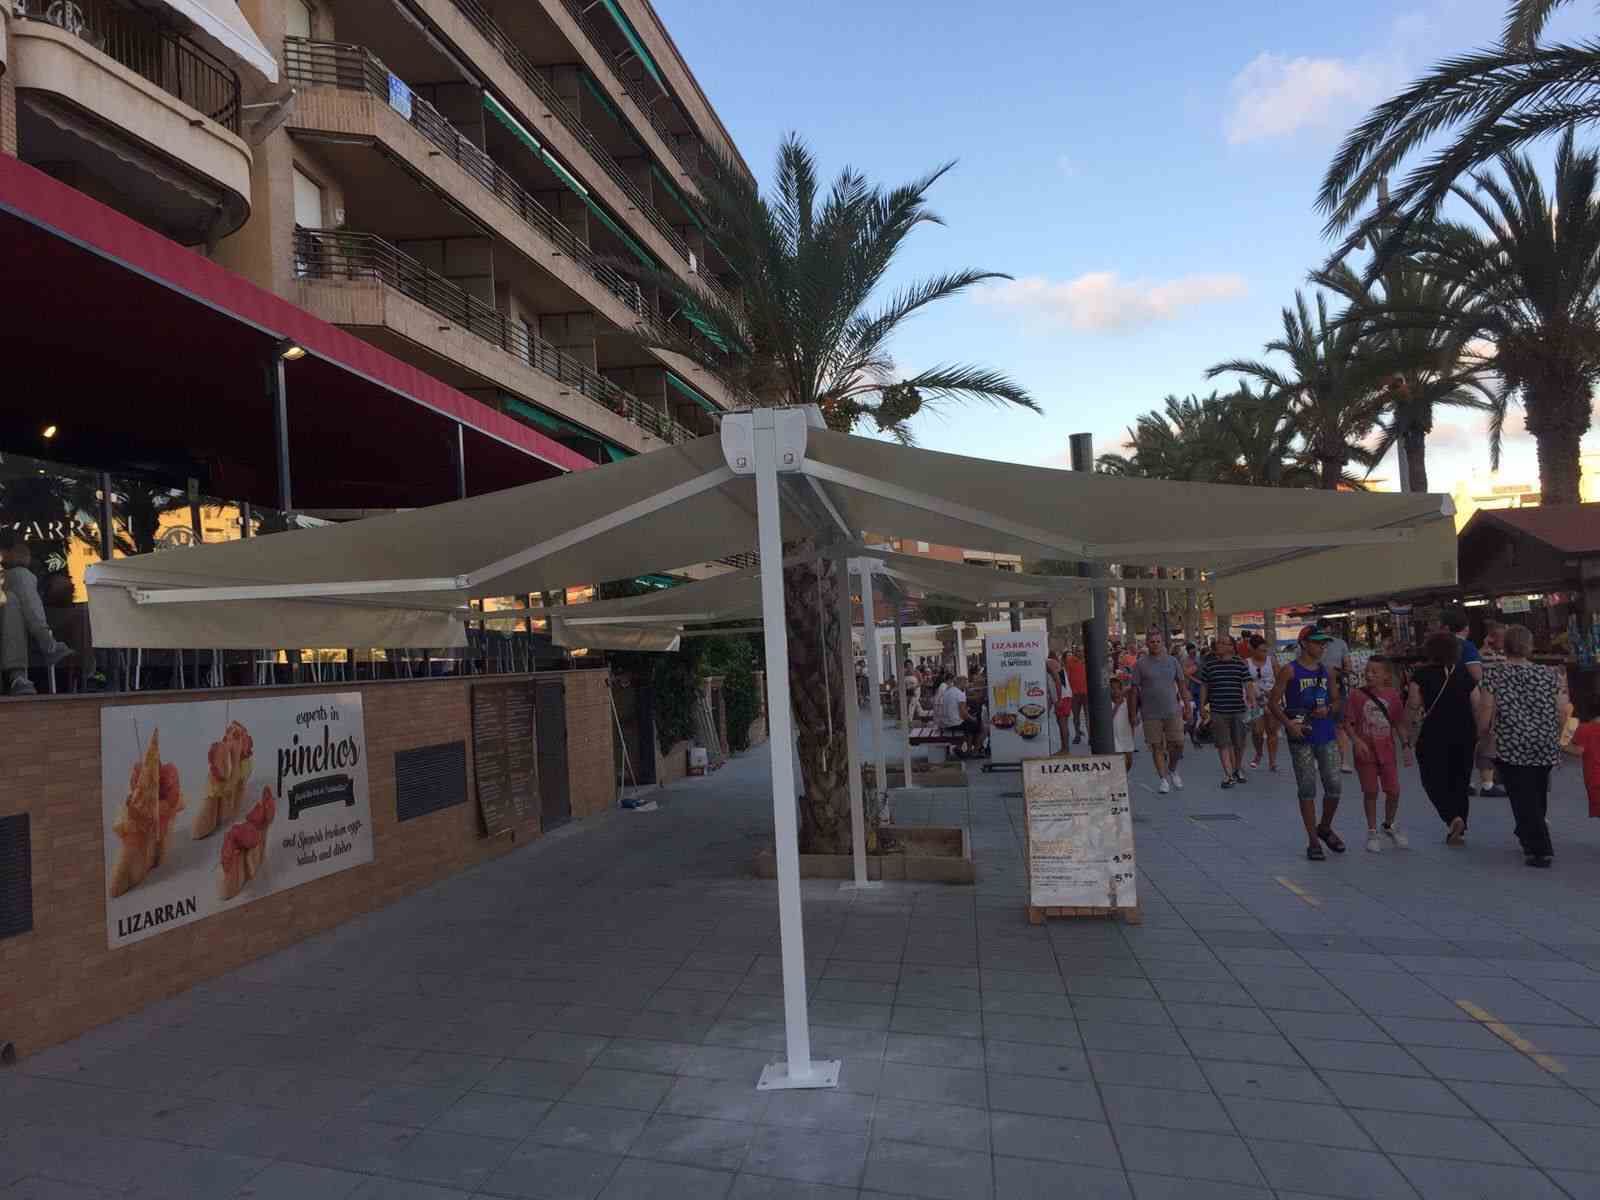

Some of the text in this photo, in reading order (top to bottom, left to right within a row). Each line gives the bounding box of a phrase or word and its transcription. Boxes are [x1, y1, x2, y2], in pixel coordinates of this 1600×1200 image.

[992, 640, 1040, 650] LIZARRAN
[296, 706, 339, 728] experts in
[277, 725, 361, 798] pinchos
[1041, 762, 1111, 774] LIZARRAN
[118, 896, 197, 937] LIZARRAN
